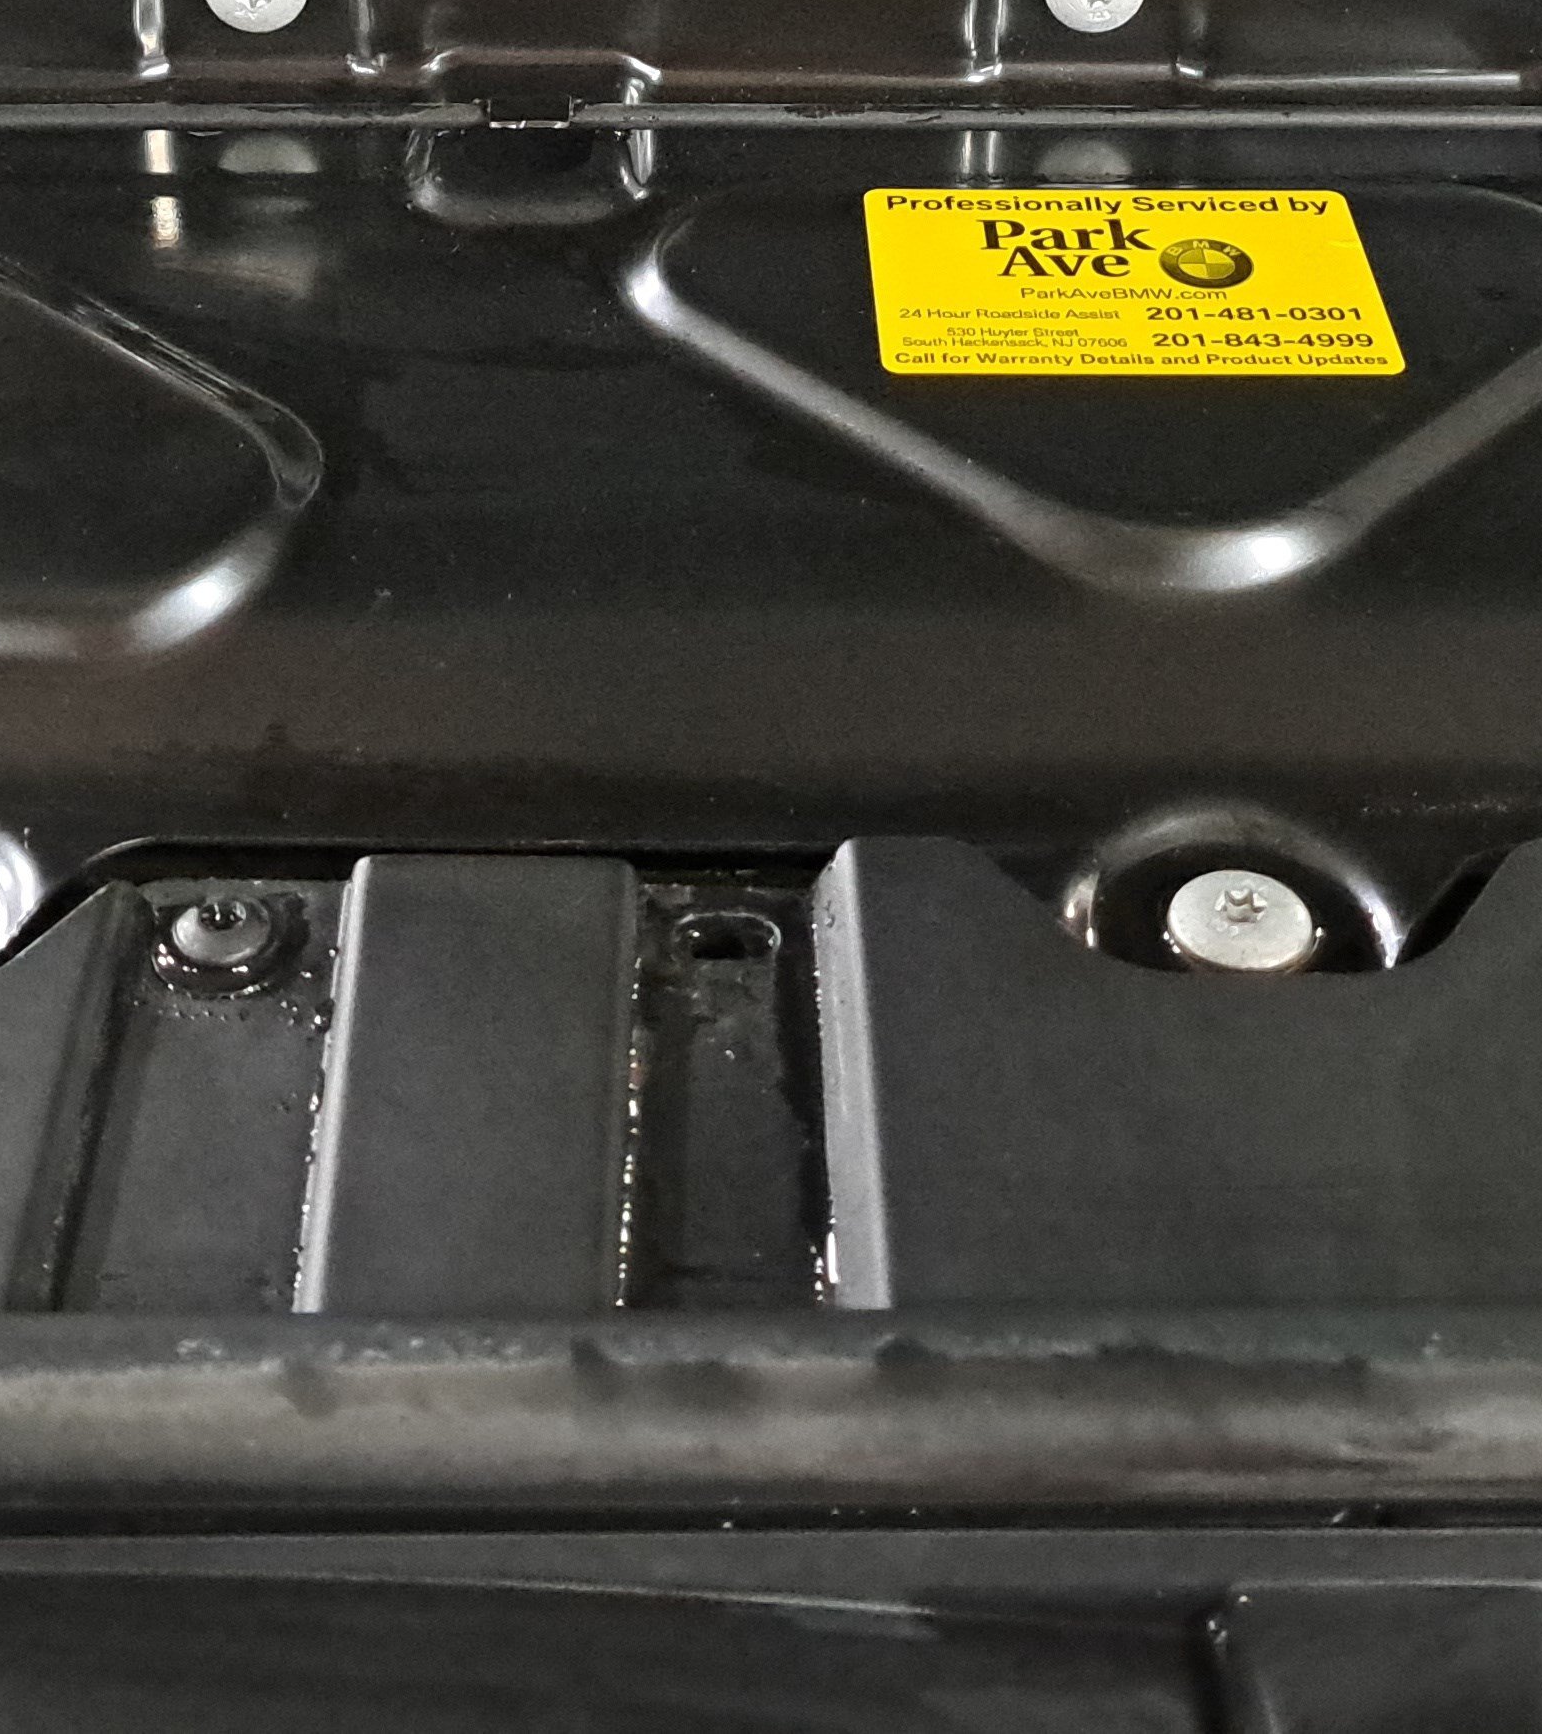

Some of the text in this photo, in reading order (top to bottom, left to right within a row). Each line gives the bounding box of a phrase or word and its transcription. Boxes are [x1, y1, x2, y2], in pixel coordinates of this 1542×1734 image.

[886, 195, 1329, 215] Professionally Serviced by
[976, 218, 1157, 251] Park
[1165, 239, 1242, 257] BMW
[997, 245, 1131, 277] Ave
[1020, 287, 1228, 300] ParkAveBMW.com
[899, 308, 1120, 319] 24 Hour Roadside Assist
[1146, 307, 1362, 321] 201-481-0301
[947, 327, 976, 337] 530
[1033, 327, 1079, 337] Street
[902, 337, 948, 347] South
[1052, 337, 1073, 347] NJ
[1078, 338, 1128, 347] 07606
[1151, 333, 1374, 347] 201-843-4999
[895, 352, 1388, 366] Call for Warranty Details and Product Updates
